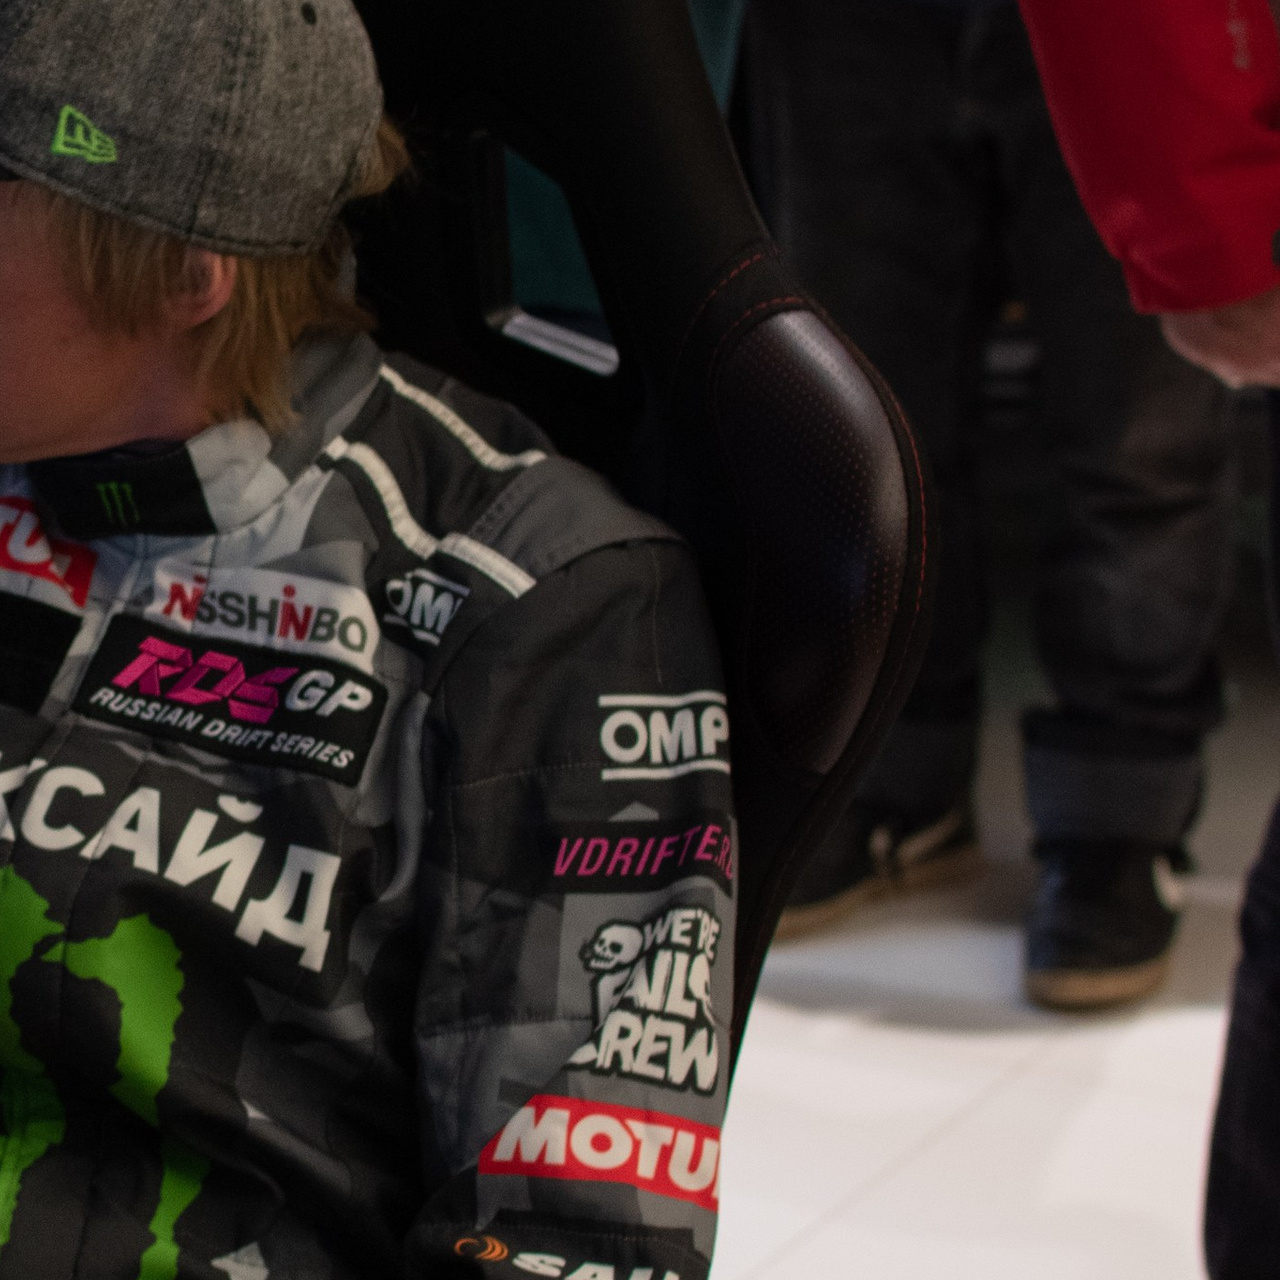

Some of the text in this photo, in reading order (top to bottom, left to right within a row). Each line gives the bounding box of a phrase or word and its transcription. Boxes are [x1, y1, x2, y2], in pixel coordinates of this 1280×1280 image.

[385, 579, 464, 635] OM
[111, 636, 374, 724] RDS GP
[89, 687, 356, 769] RUSSIAN DRIFT SERIES
[600, 705, 729, 764] OMP
[493, 1106, 720, 1199] MOTU
